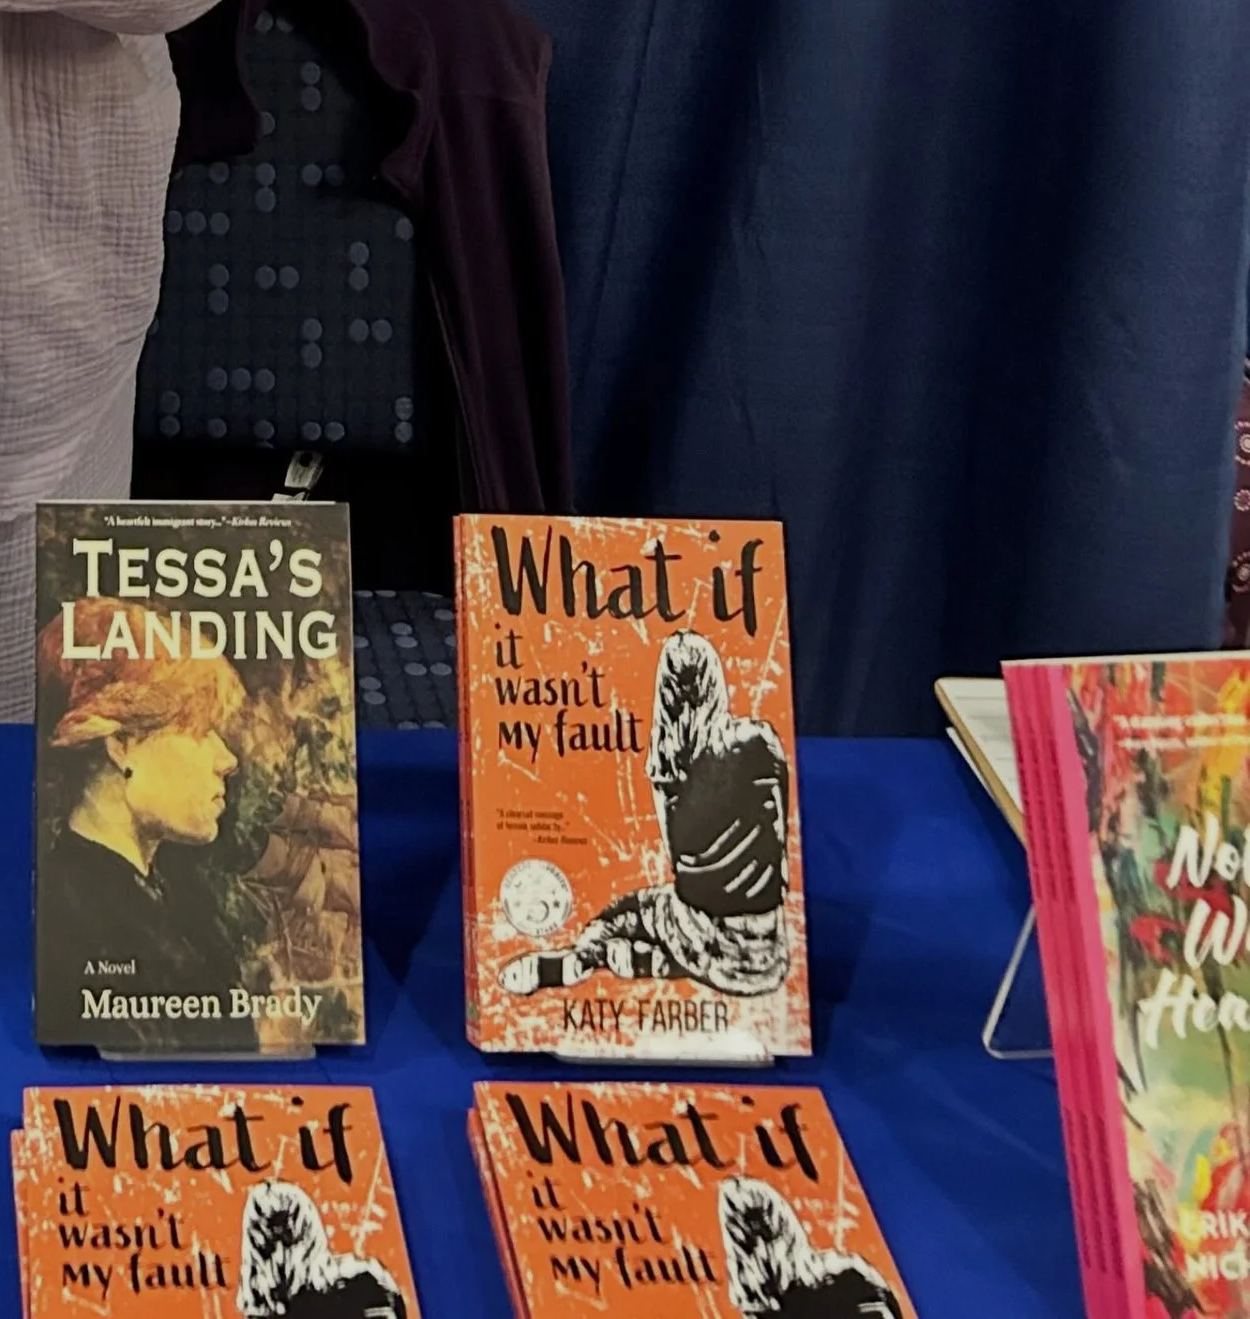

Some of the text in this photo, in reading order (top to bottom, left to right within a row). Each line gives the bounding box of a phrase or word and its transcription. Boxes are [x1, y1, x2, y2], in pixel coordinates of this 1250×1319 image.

[72, 538, 323, 598] TESSA'S
[491, 525, 764, 637] What if
[61, 601, 338, 661] LANDING
[494, 622, 523, 670] it
[494, 661, 607, 708] wasn't
[554, 710, 645, 759] fault
[84, 959, 136, 975] A Novel
[81, 985, 322, 1026] Maureen Brady
[563, 999, 728, 1032] KATY FARBER
[54, 1096, 353, 1186] What if
[505, 1092, 819, 1183] What if
[58, 1177, 90, 1217] it
[526, 1170, 566, 1211] it
[57, 1208, 190, 1250] wasn't
[537, 1203, 666, 1246] wasn't
[120, 1251, 232, 1294] fault
[610, 1245, 721, 1292] fault
